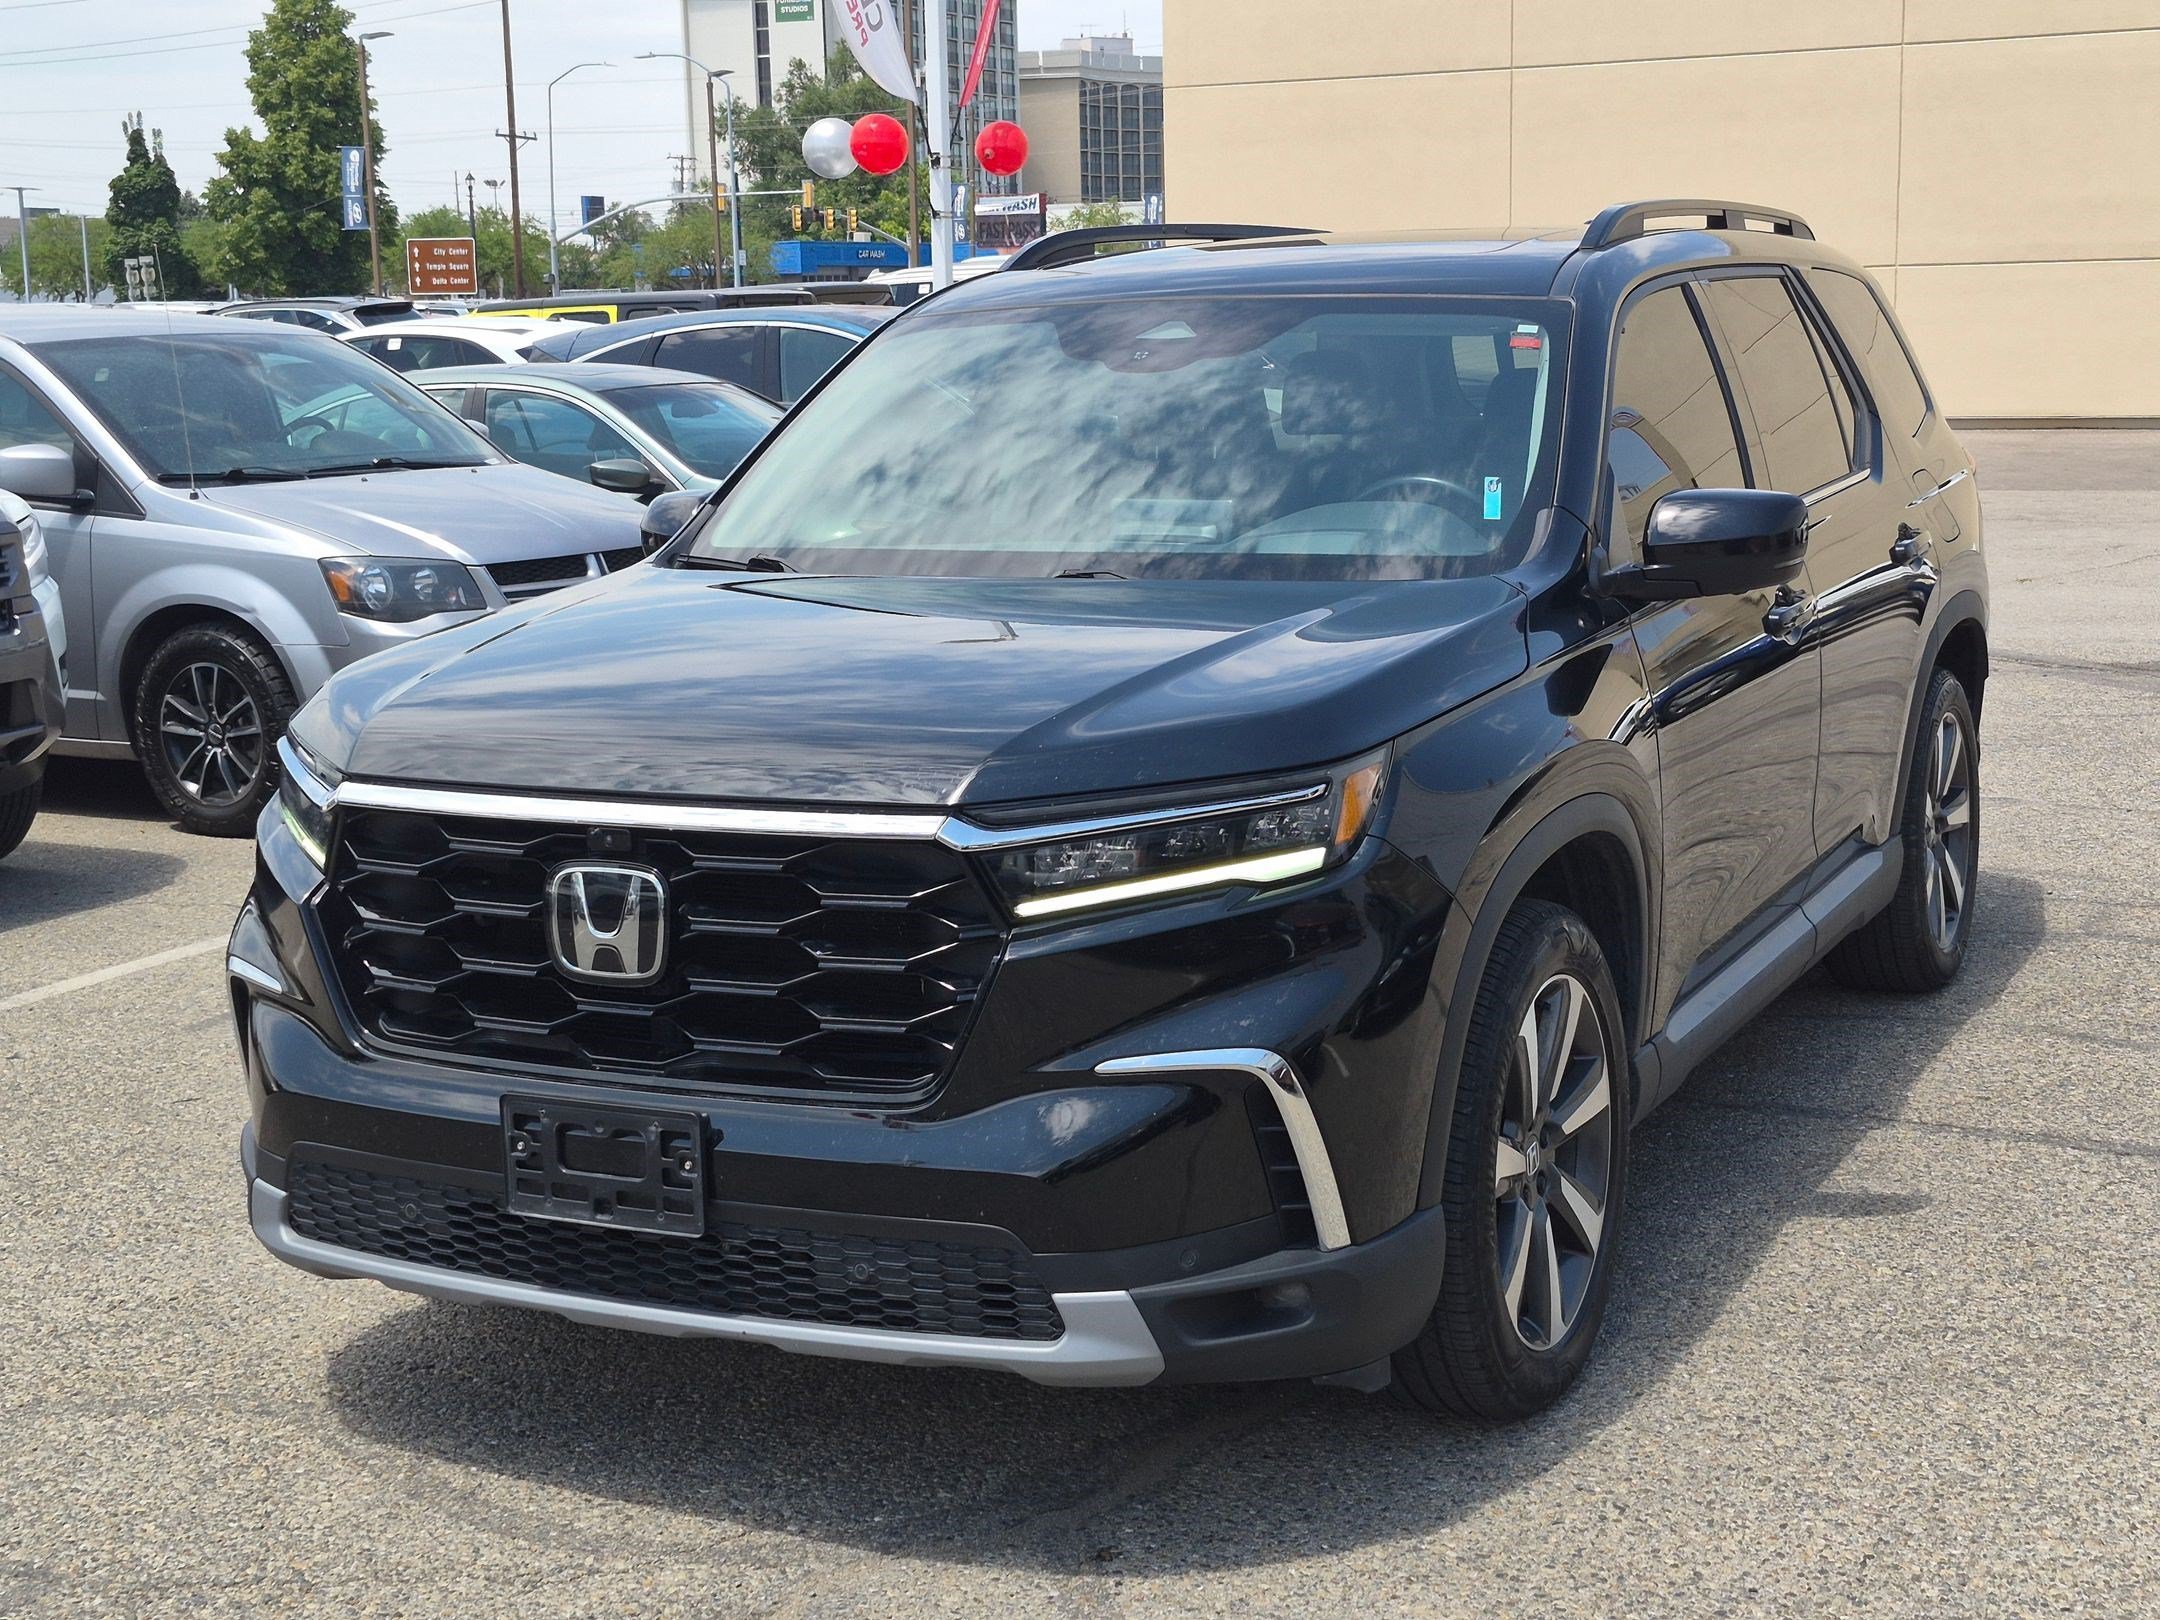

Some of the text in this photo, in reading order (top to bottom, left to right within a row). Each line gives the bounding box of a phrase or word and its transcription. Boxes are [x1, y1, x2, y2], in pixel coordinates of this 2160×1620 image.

[780, 5, 809, 14] STUDIOS
[433, 247, 469, 257] City Center
[858, 249, 886, 258] CAR WASH
[426, 262, 469, 271] Temple Square
[432, 277, 470, 285] Delta Center
